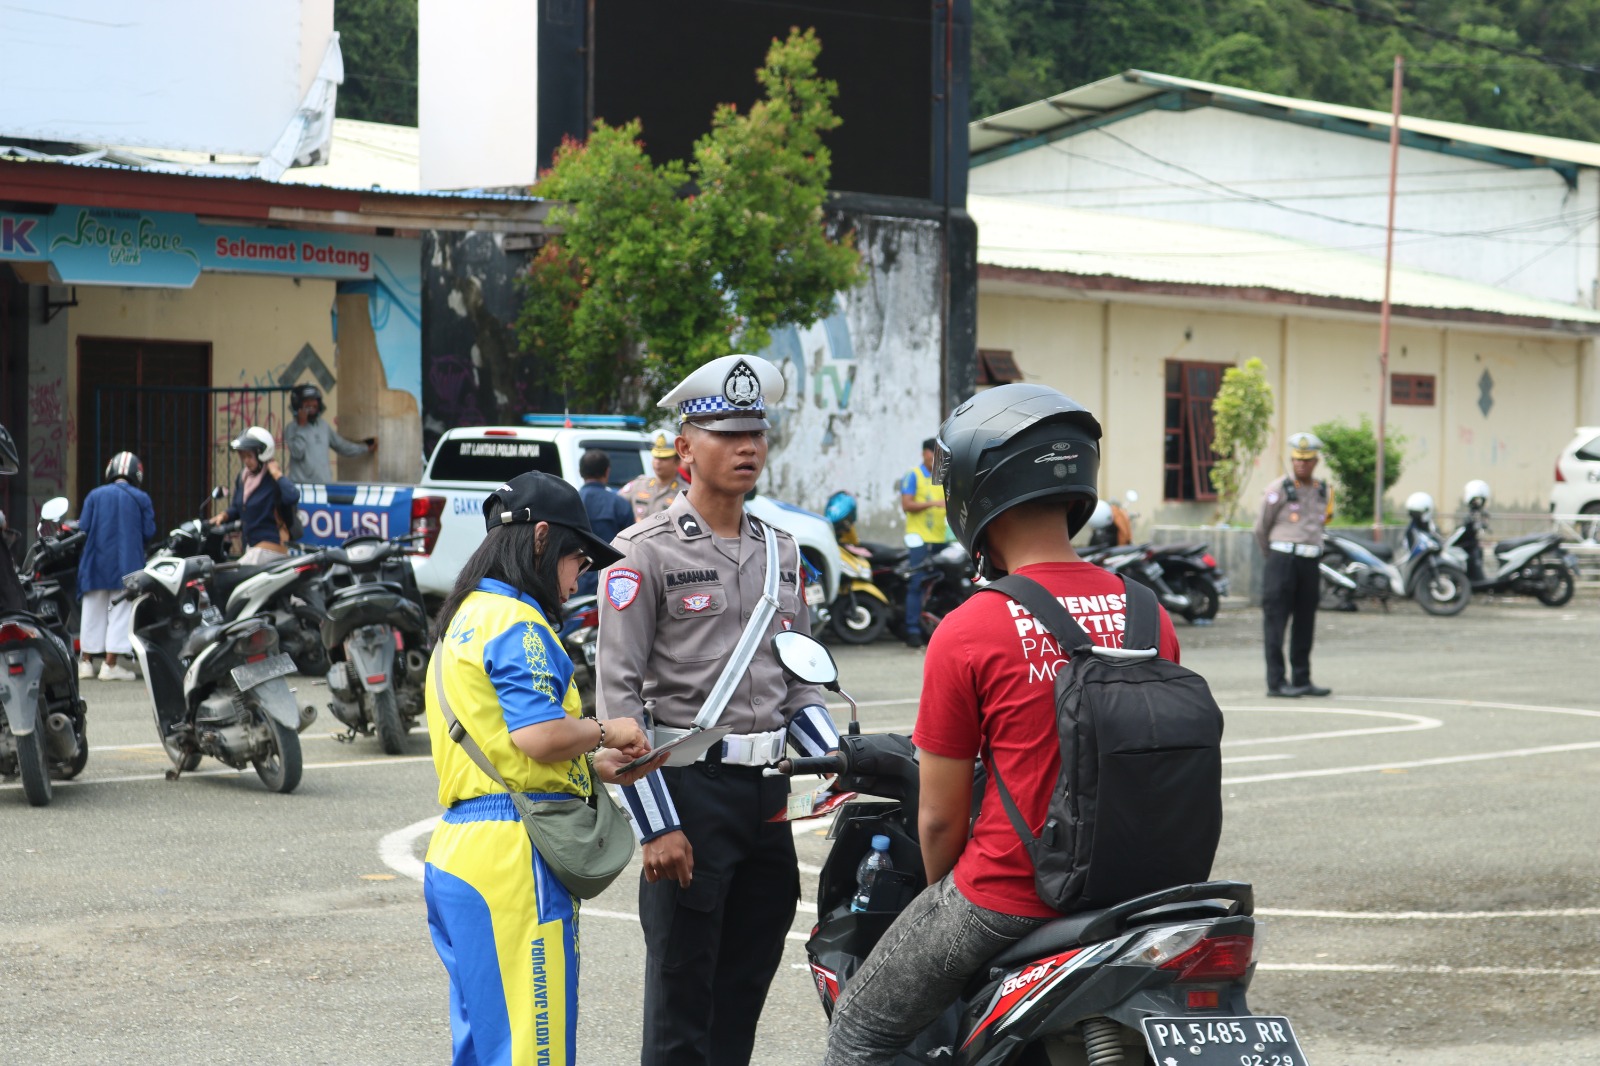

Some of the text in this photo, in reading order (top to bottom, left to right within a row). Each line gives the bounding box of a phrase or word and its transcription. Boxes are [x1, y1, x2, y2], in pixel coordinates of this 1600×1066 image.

[1, 217, 38, 254] K
[109, 248, 140, 265] Park
[215, 236, 371, 272] Selamat Datang
[454, 497, 484, 515] GAKK
[297, 510, 388, 541] POLISI
[531, 937, 549, 1009] JAYAPURA
[535, 1011, 550, 1046] KOTA
[1154, 1021, 1288, 1047] PA 5485 RR
